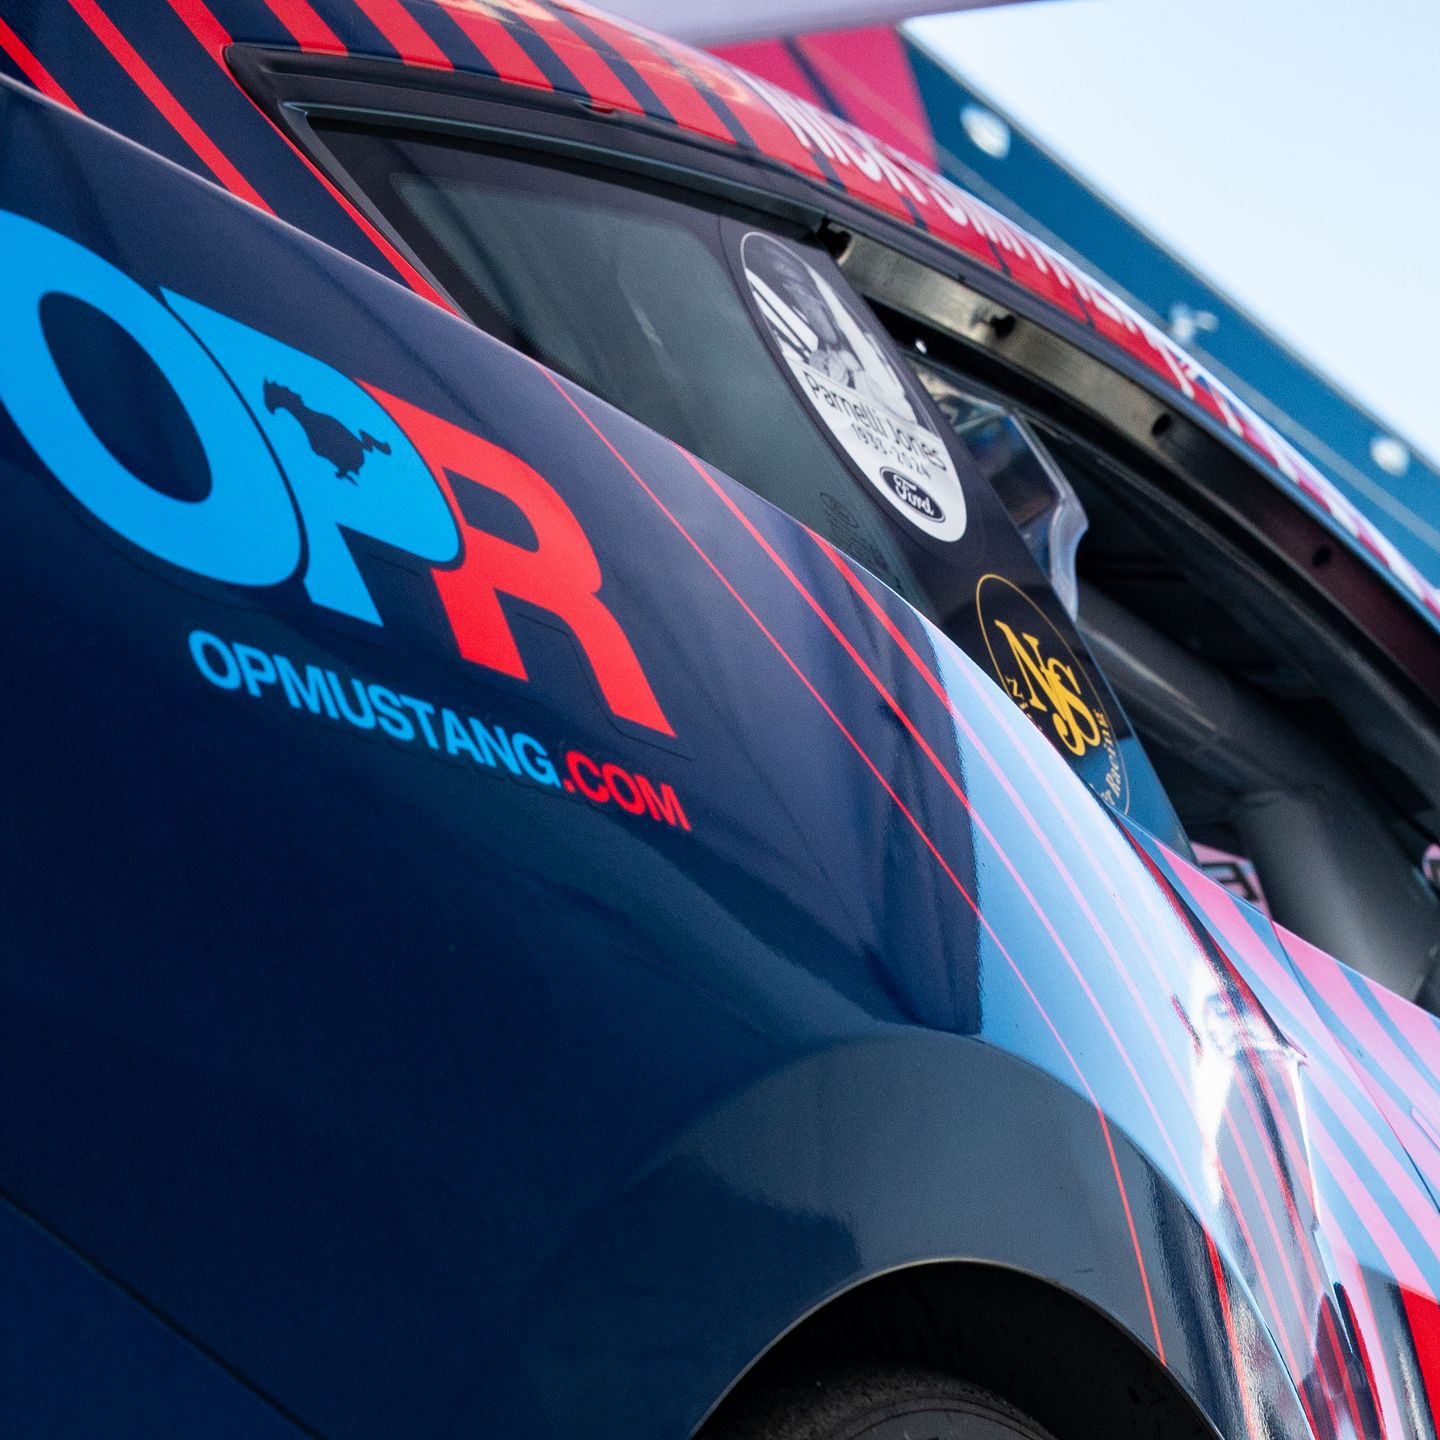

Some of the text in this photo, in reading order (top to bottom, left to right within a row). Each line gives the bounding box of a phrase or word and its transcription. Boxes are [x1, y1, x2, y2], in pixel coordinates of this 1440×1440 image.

[0, 209, 677, 738] OPR
[803, 371, 947, 472] Parnelli Jones
[893, 474, 934, 516] Ford
[189, 629, 692, 831] OPMUSTANG.COM
